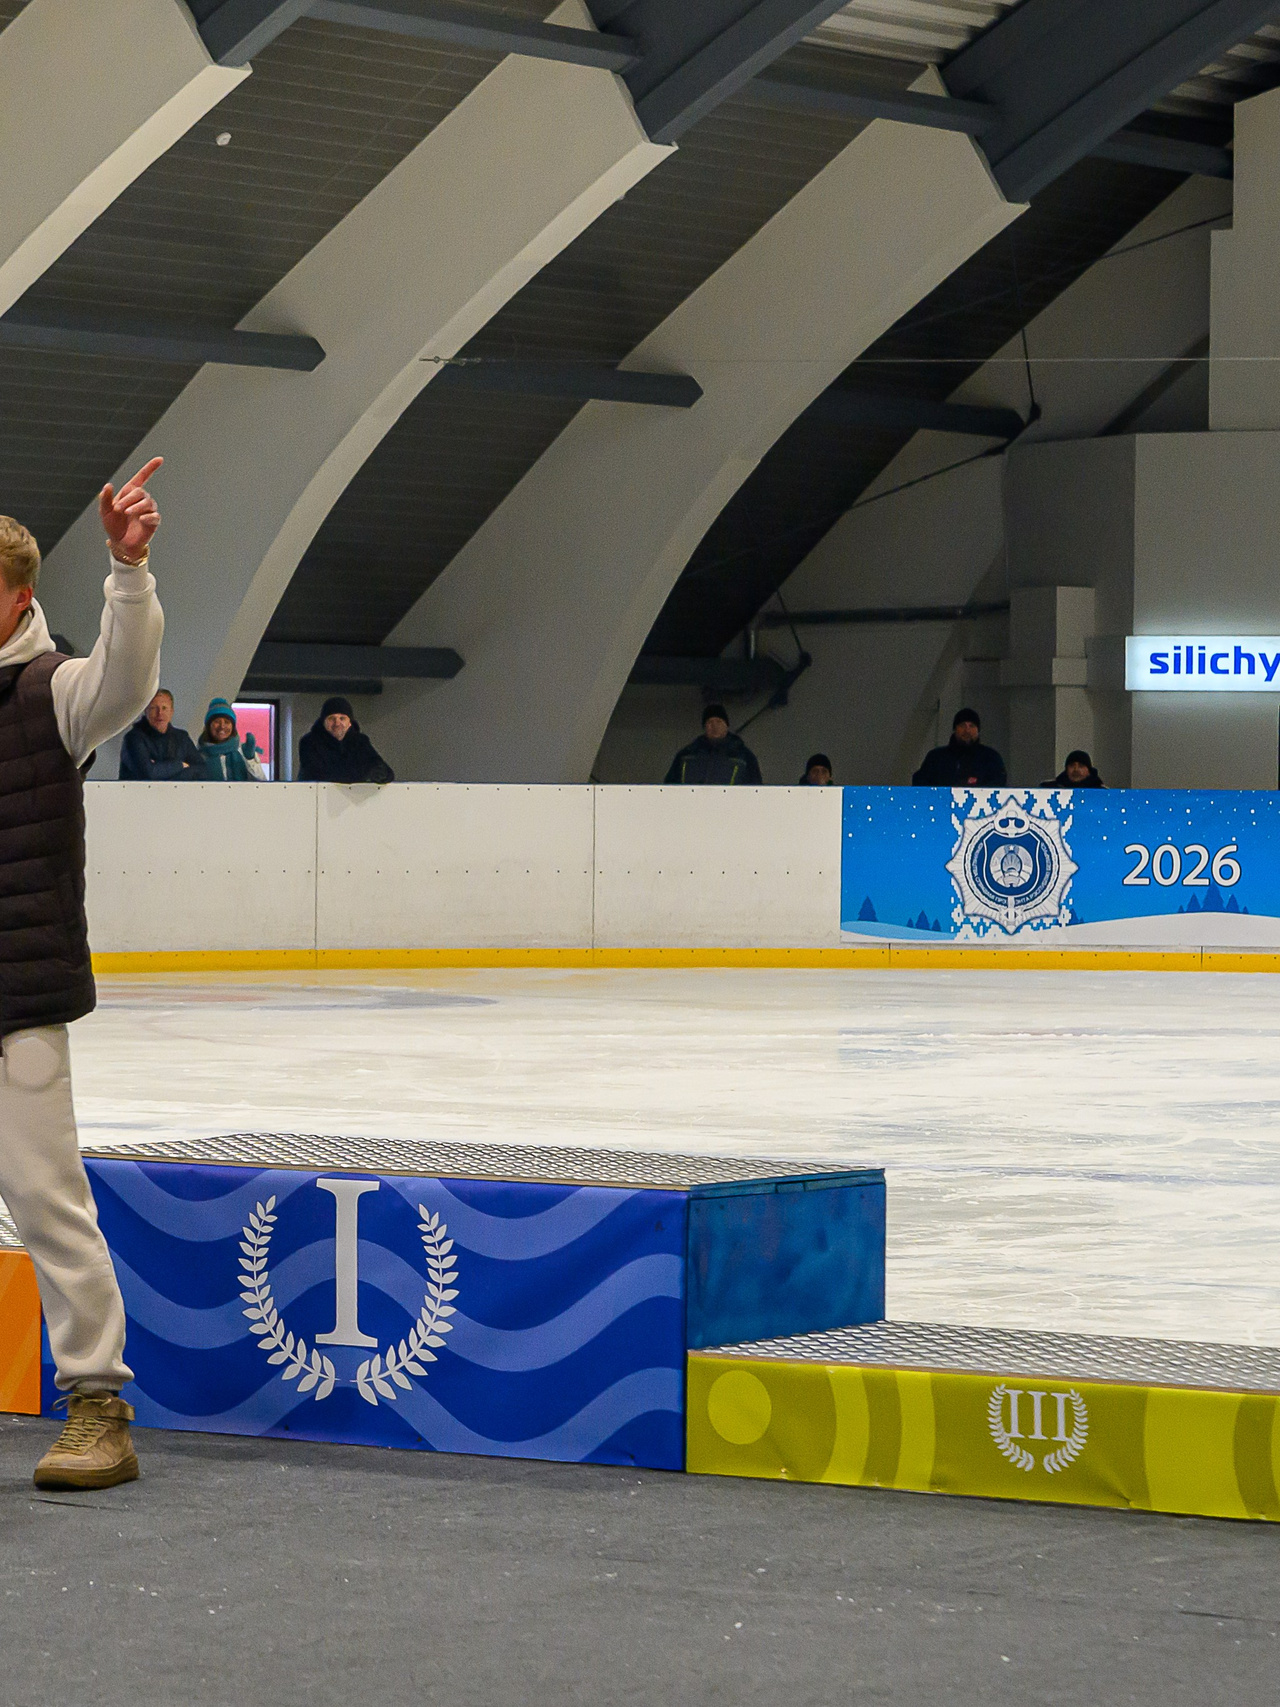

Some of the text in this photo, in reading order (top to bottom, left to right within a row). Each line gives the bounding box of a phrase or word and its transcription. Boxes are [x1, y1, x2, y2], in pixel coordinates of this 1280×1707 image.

[1149, 645, 1280, 682] silichy
[1122, 843, 1242, 887] 2026
[1004, 1388, 1074, 1442] III
